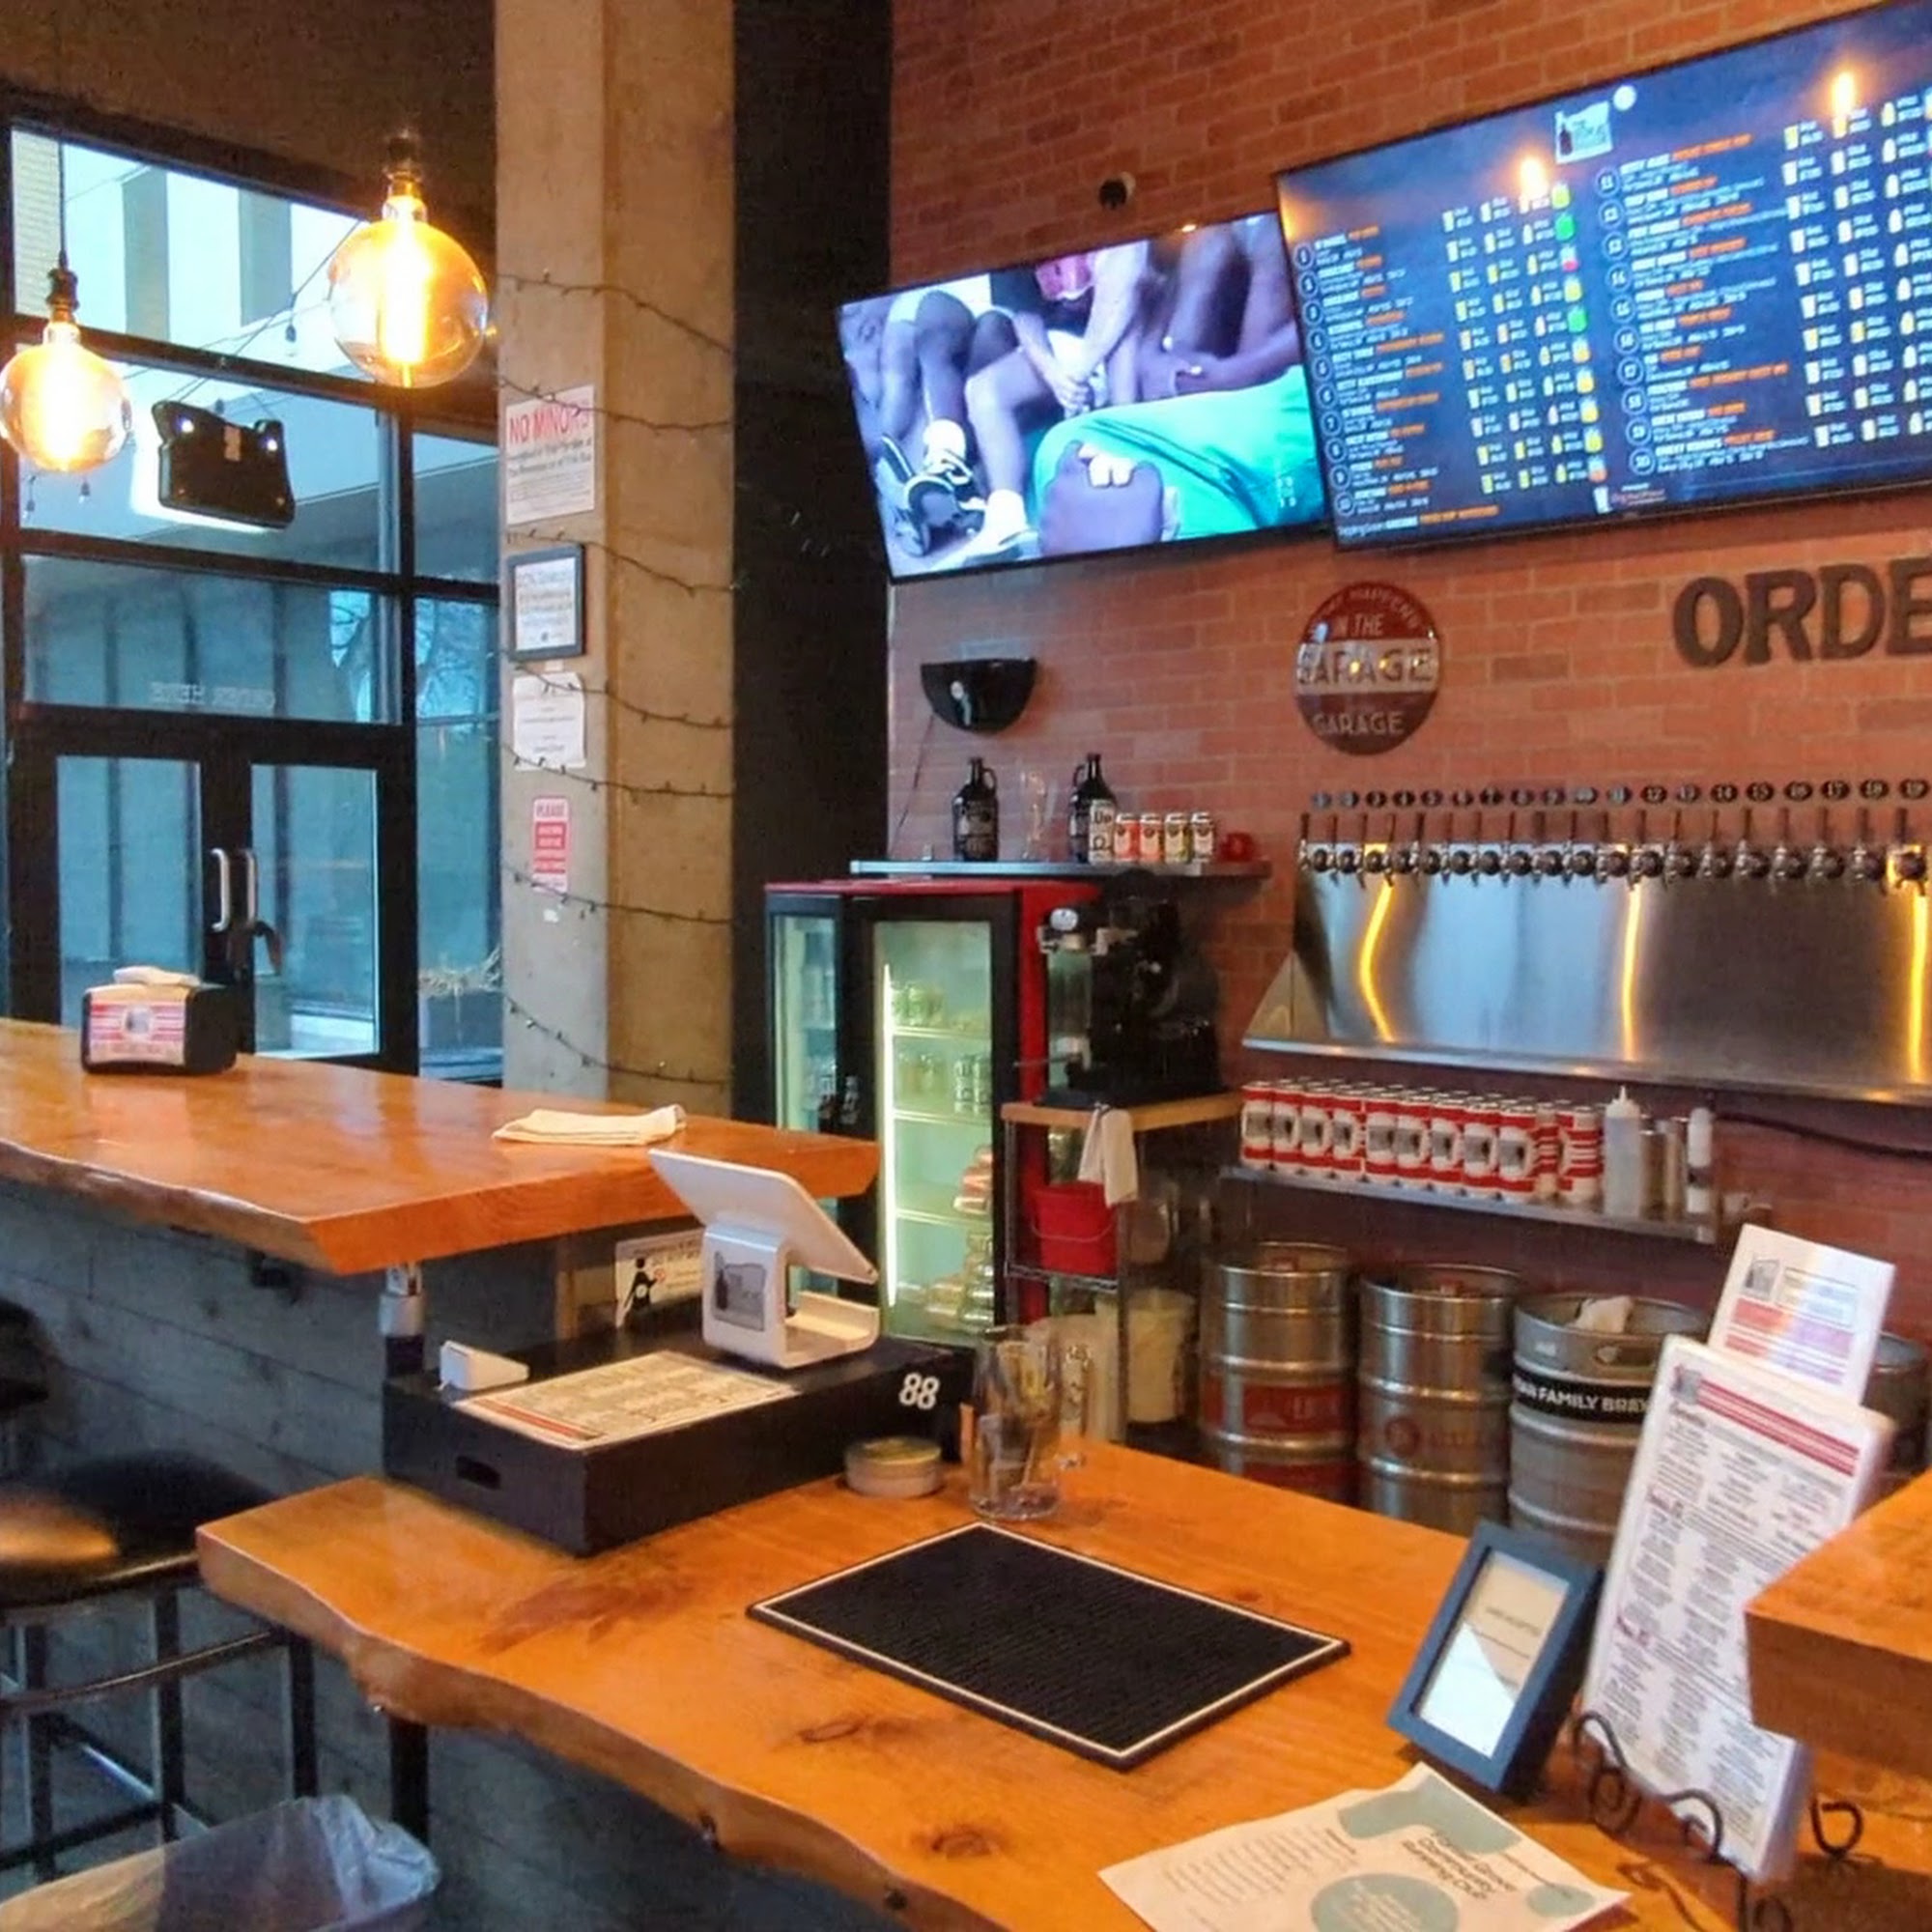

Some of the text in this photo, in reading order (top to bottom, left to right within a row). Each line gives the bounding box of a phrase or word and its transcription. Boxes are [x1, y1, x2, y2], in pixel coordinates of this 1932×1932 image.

[510, 414, 529, 444] NO
[1354, 611, 1385, 638] THE
[1673, 556, 1932, 668] ORDE
[1298, 645, 1435, 686] GARAGE
[1311, 710, 1406, 737] GARAGE
[898, 1372, 941, 1411] 88
[1539, 1385, 1599, 1410] FAMILY
